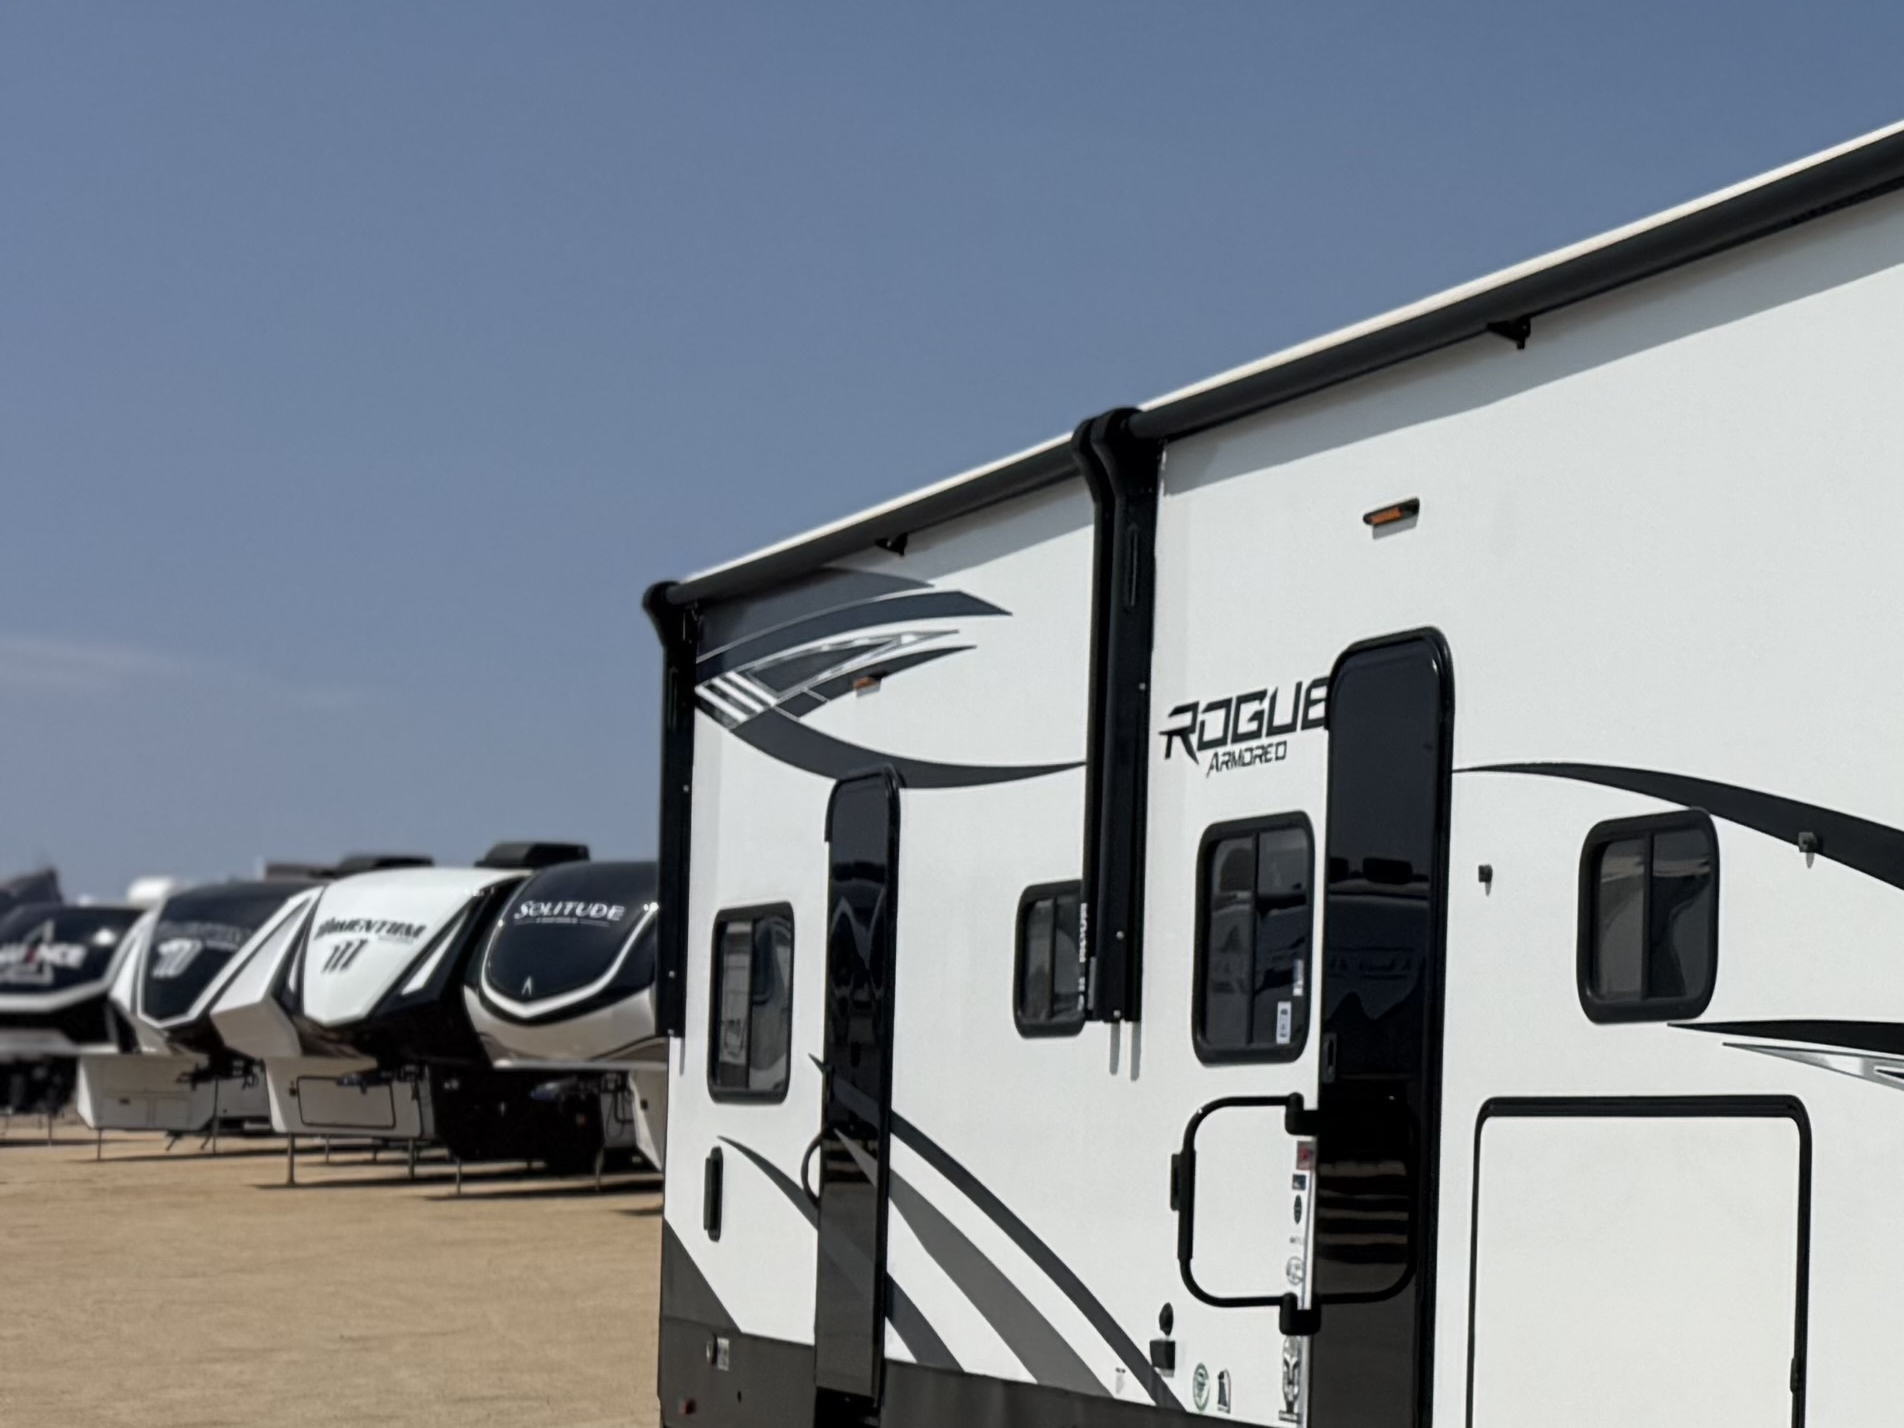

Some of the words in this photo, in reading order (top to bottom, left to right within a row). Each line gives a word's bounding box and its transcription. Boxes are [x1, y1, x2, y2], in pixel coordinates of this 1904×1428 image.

[1158, 676, 1331, 767] ROGUE
[1206, 740, 1288, 780] ARMORED
[514, 900, 625, 921] SOLITUDE
